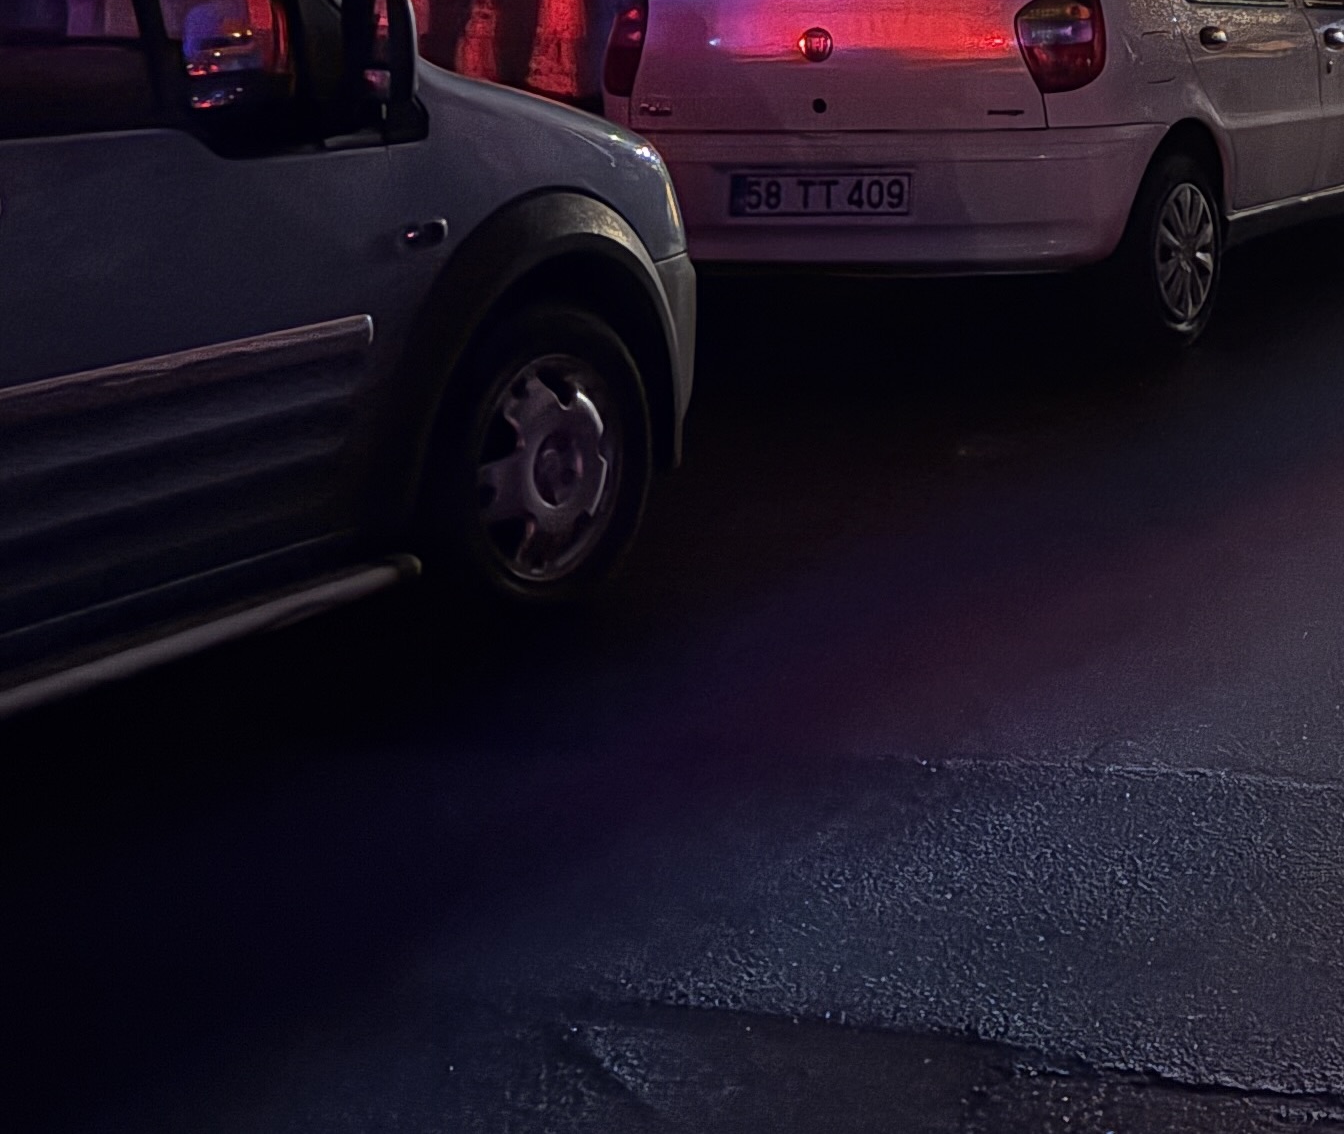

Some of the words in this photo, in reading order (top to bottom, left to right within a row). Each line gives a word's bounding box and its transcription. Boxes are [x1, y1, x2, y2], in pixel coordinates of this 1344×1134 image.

[746, 179, 782, 210] 58
[796, 179, 840, 210] TT
[846, 179, 904, 210] 409
